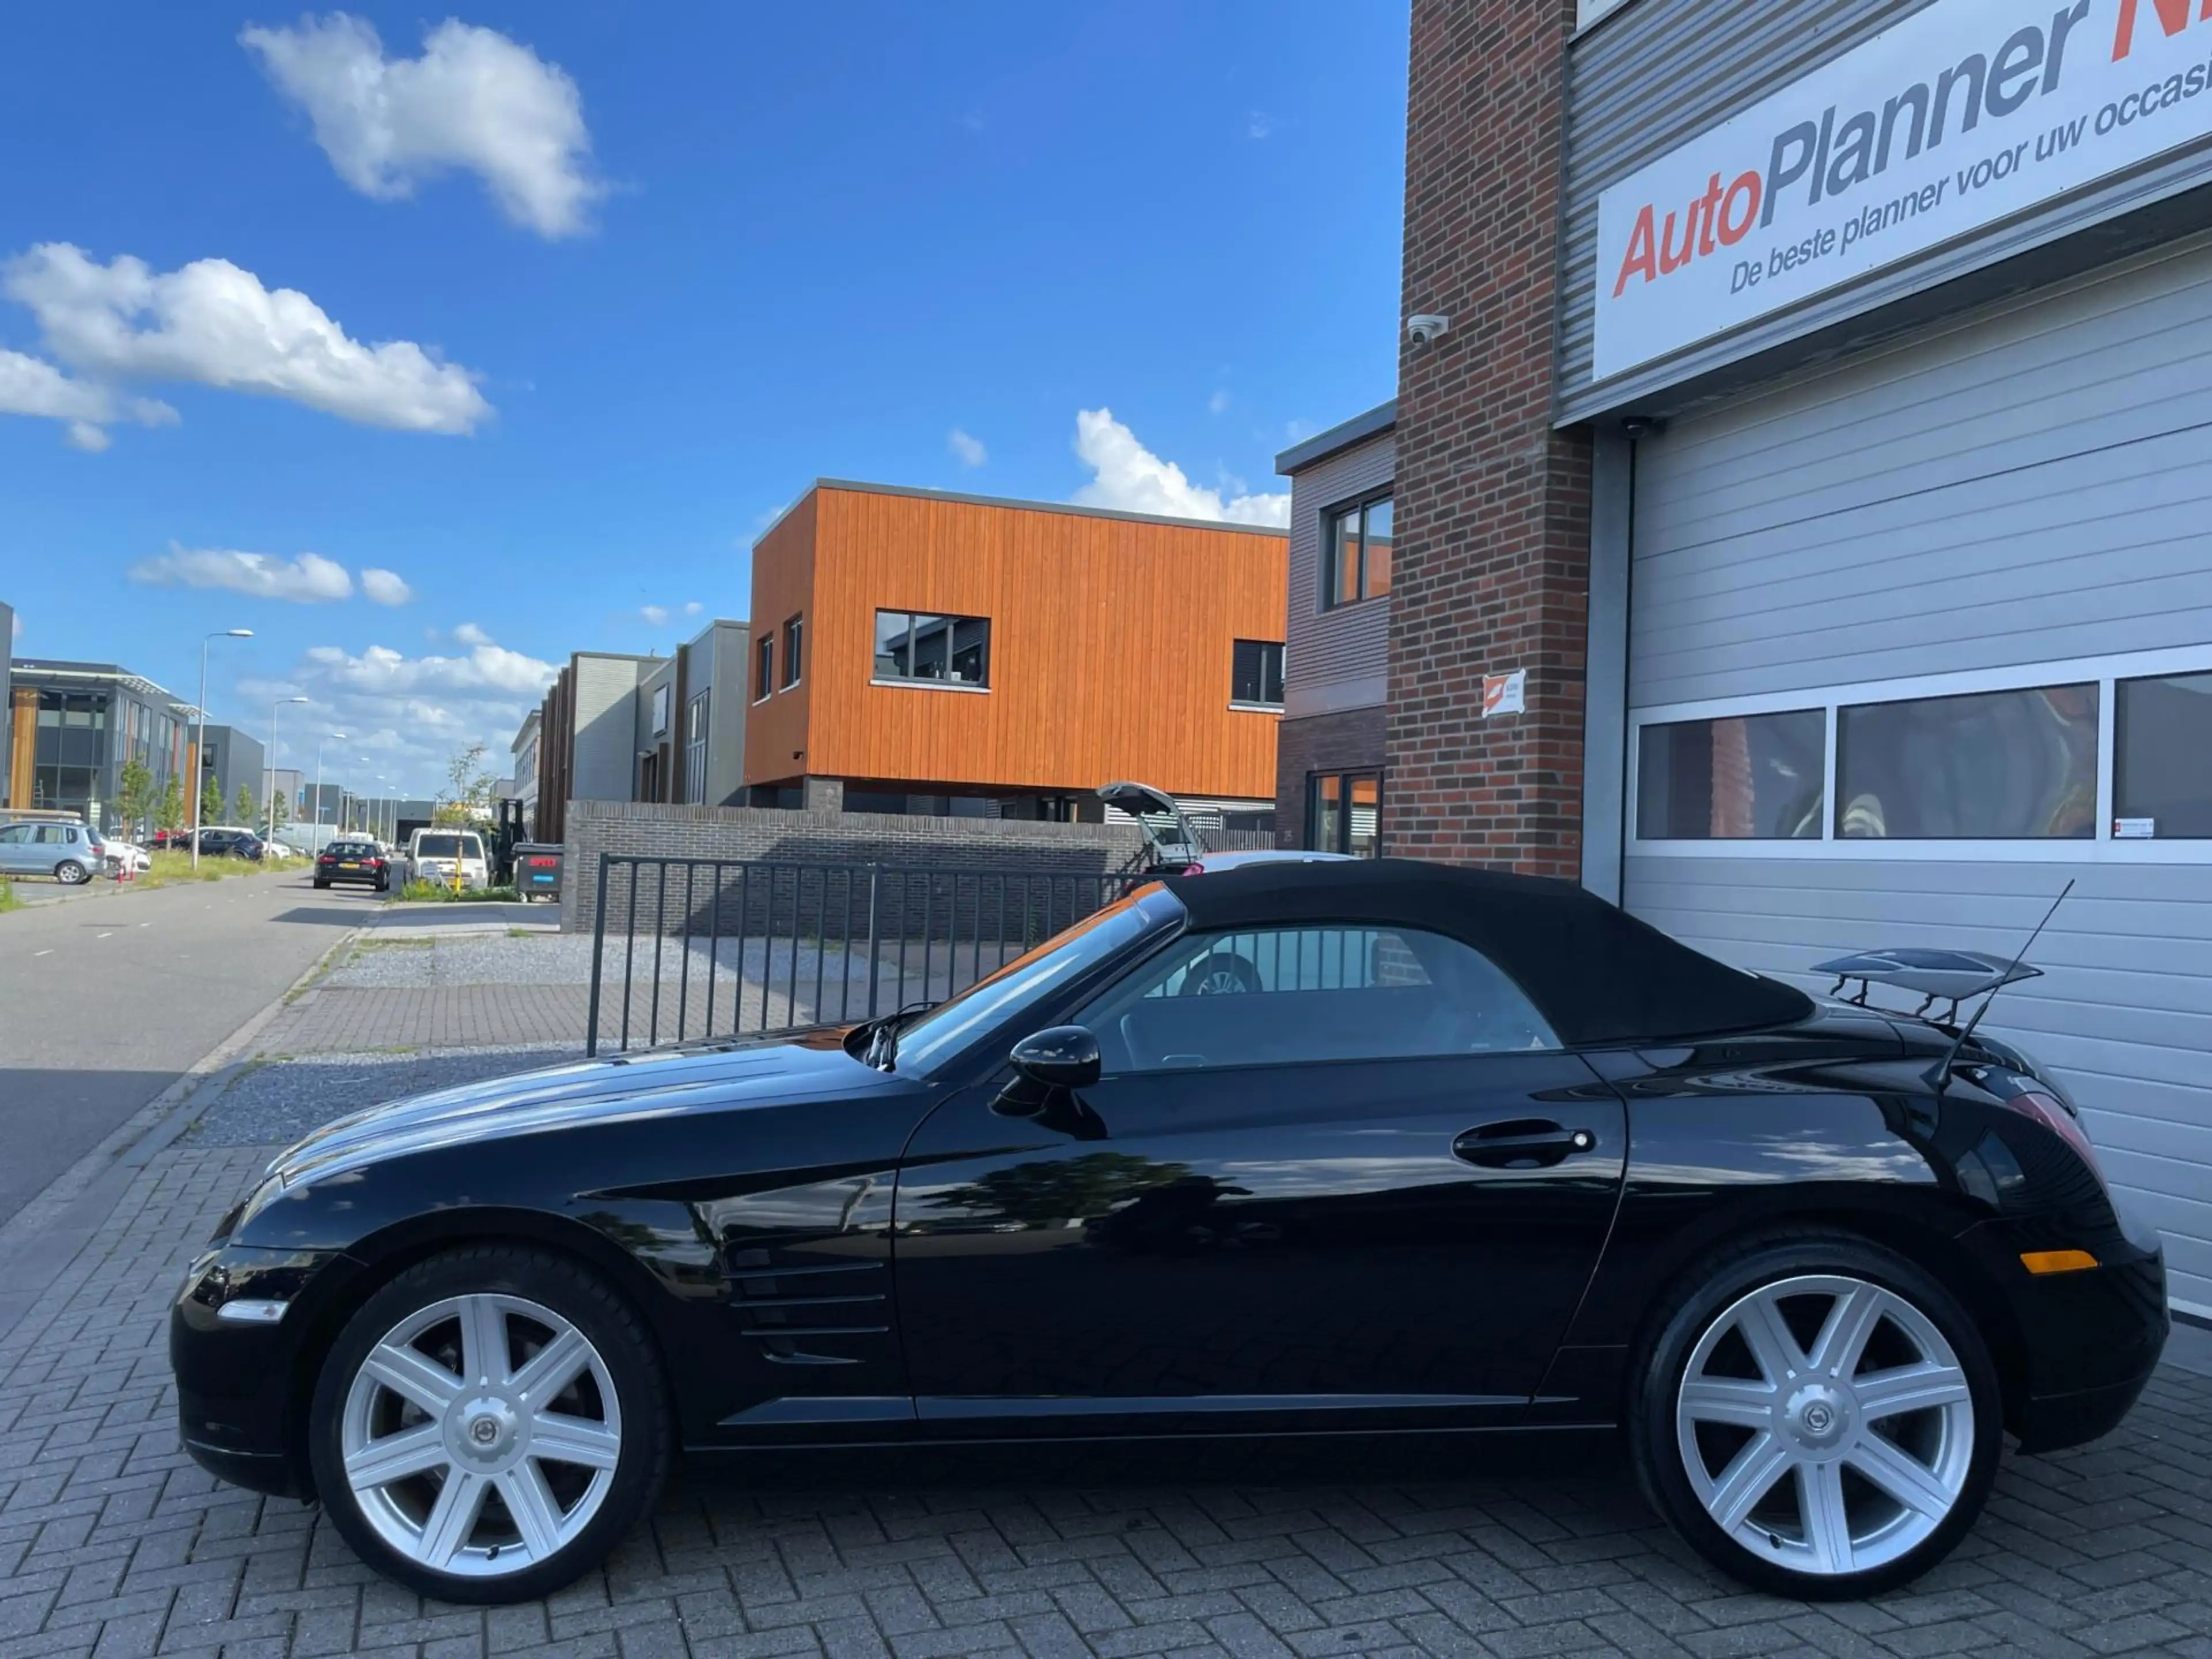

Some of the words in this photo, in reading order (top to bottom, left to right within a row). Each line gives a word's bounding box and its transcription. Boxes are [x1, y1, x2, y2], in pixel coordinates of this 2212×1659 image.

[1612, 0, 2090, 298] AutoPlanner
[1730, 260, 1762, 295] De
[1767, 229, 1836, 279] beste
[1840, 176, 1949, 256] planner
[1957, 141, 2029, 195] voor
[2035, 113, 2088, 162] uw
